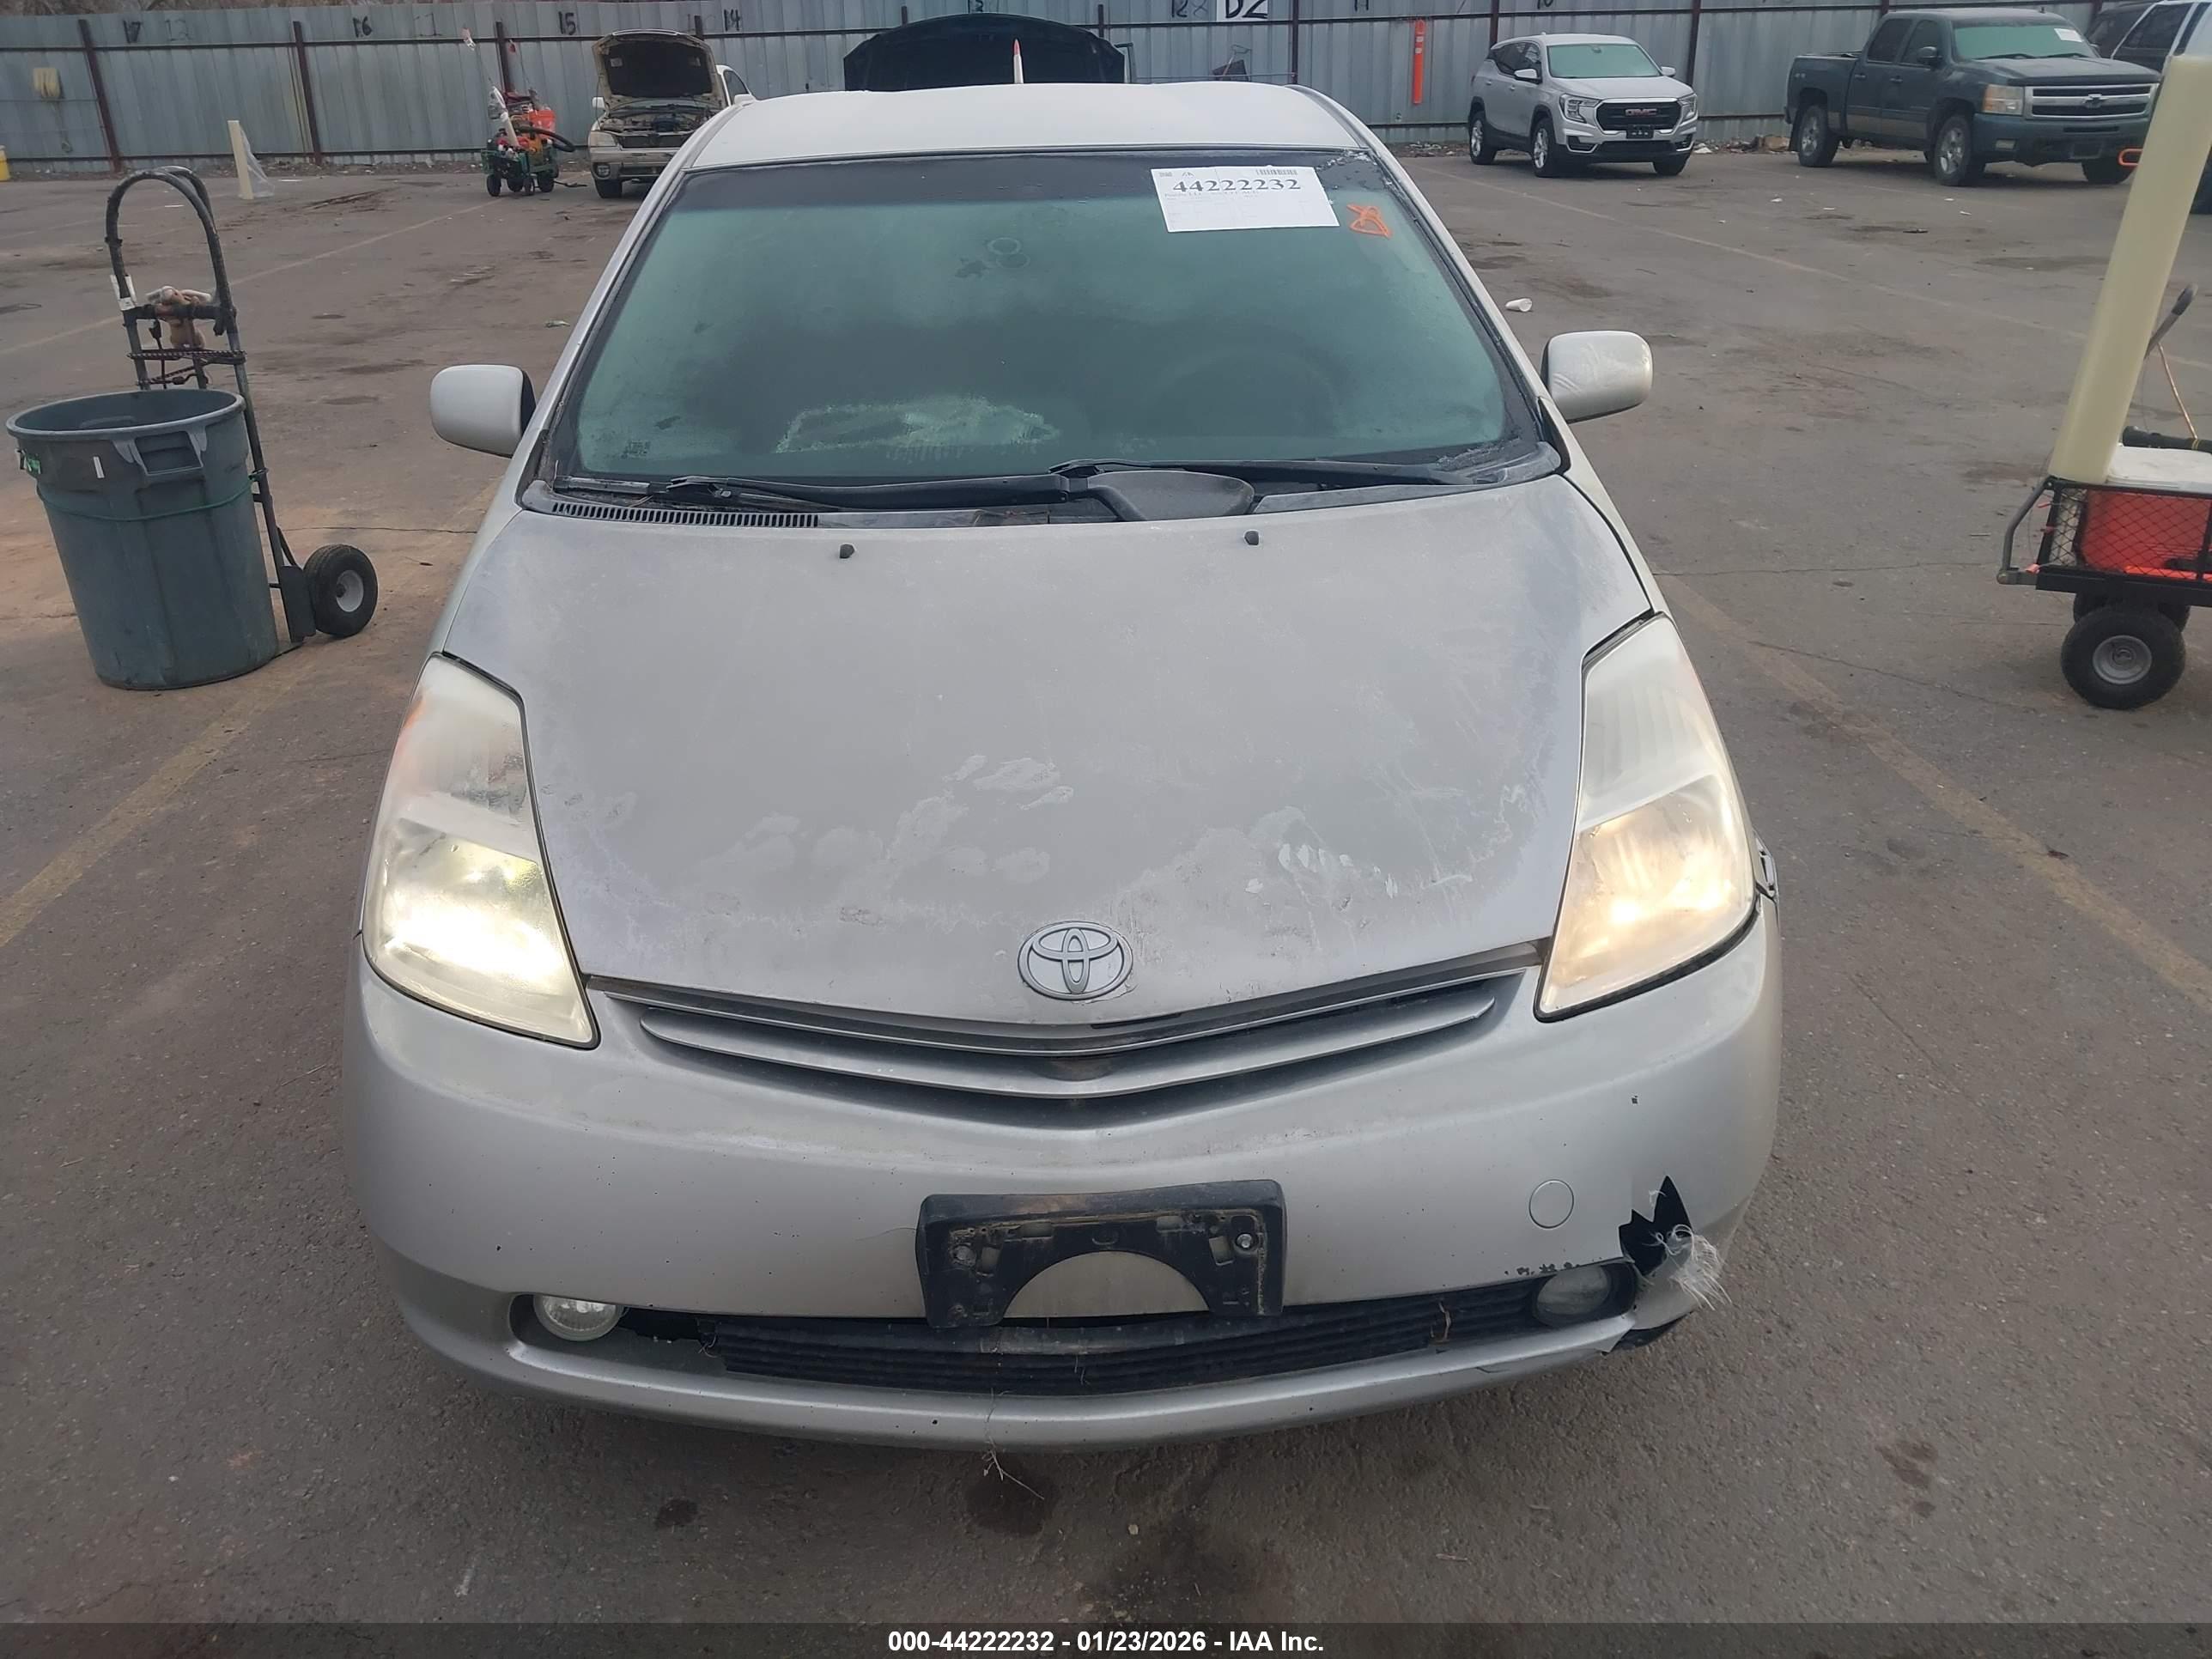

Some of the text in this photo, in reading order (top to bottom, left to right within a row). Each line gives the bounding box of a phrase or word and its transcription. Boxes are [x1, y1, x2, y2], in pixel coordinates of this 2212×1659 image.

[123, 20, 141, 43] 17
[353, 15, 372, 38] 16
[558, 11, 576, 35] 15
[724, 9, 740, 31] 14
[1173, 179, 1301, 192] 44222232
